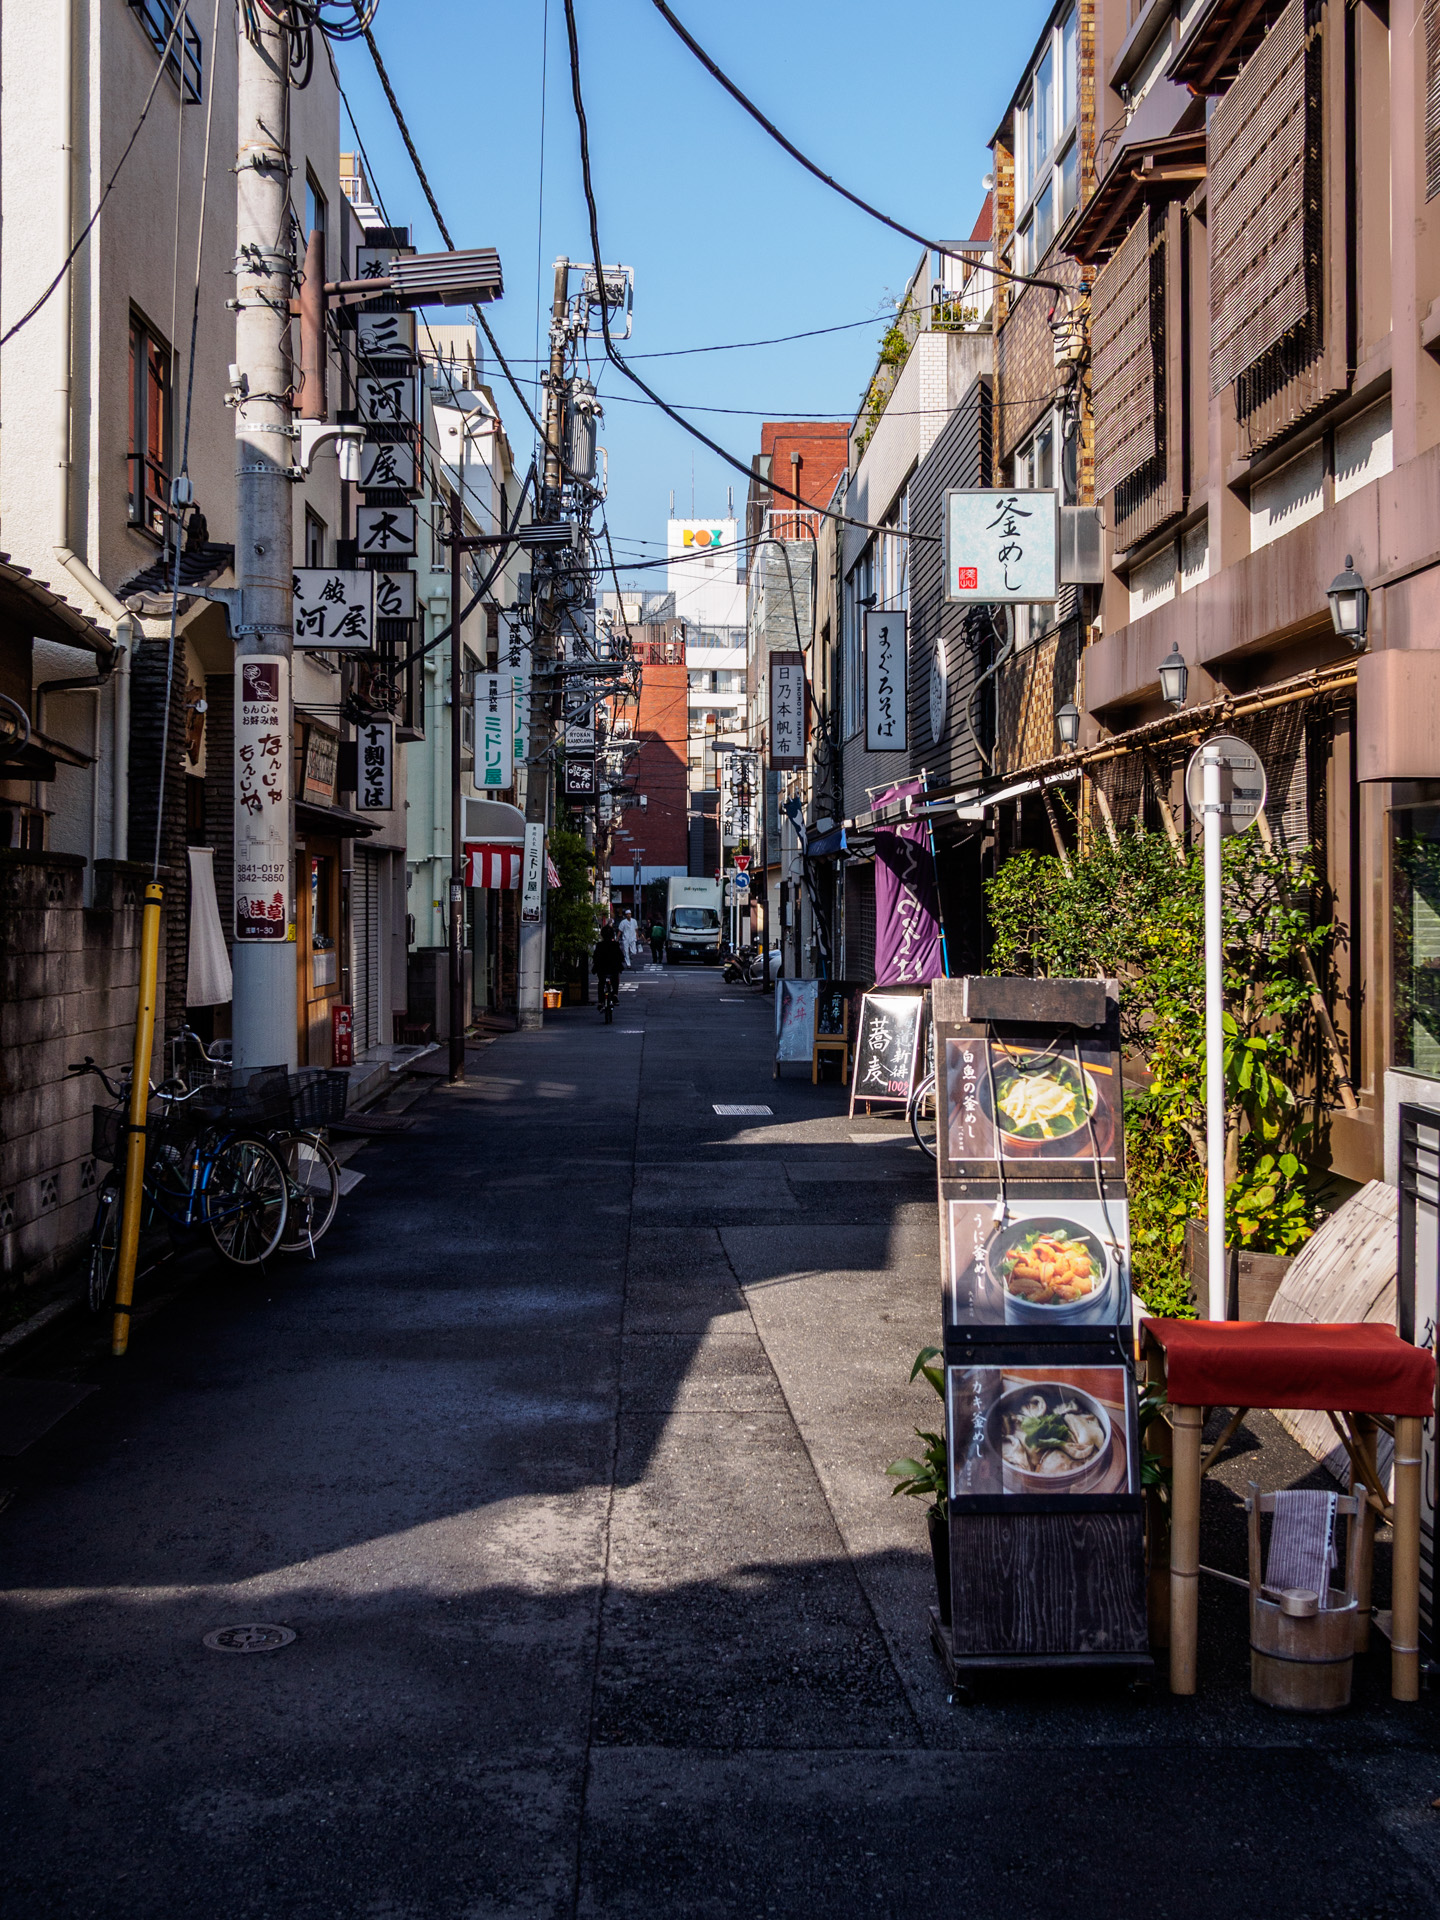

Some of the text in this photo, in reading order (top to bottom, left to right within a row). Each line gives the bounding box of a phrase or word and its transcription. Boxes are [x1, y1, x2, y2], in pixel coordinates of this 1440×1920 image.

[683, 530, 723, 546] ROX
[986, 497, 1033, 591] 釜めし
[242, 704, 278, 714] もんじゃ
[877, 626, 896, 737] まぐろそば
[242, 715, 279, 726] お好み焼
[776, 666, 793, 754] 日乃本帆布
[364, 725, 386, 808] 十割そば
[484, 716, 502, 785] ミドリ屋
[569, 780, 591, 789] Cafe
[237, 864, 285, 873] 3841-0197
[237, 874, 285, 882] 3842-5850
[528, 848, 538, 891] ミドリ屋
[249, 899, 283, 921] 浅草
[862, 1015, 892, 1085] 蕎麦
[887, 1080, 910, 1096] 100%
[962, 1050, 979, 1139] 白魚の釜めし
[972, 1213, 989, 1290] うに釜めし
[972, 1380, 988, 1458] カキ釜めし
